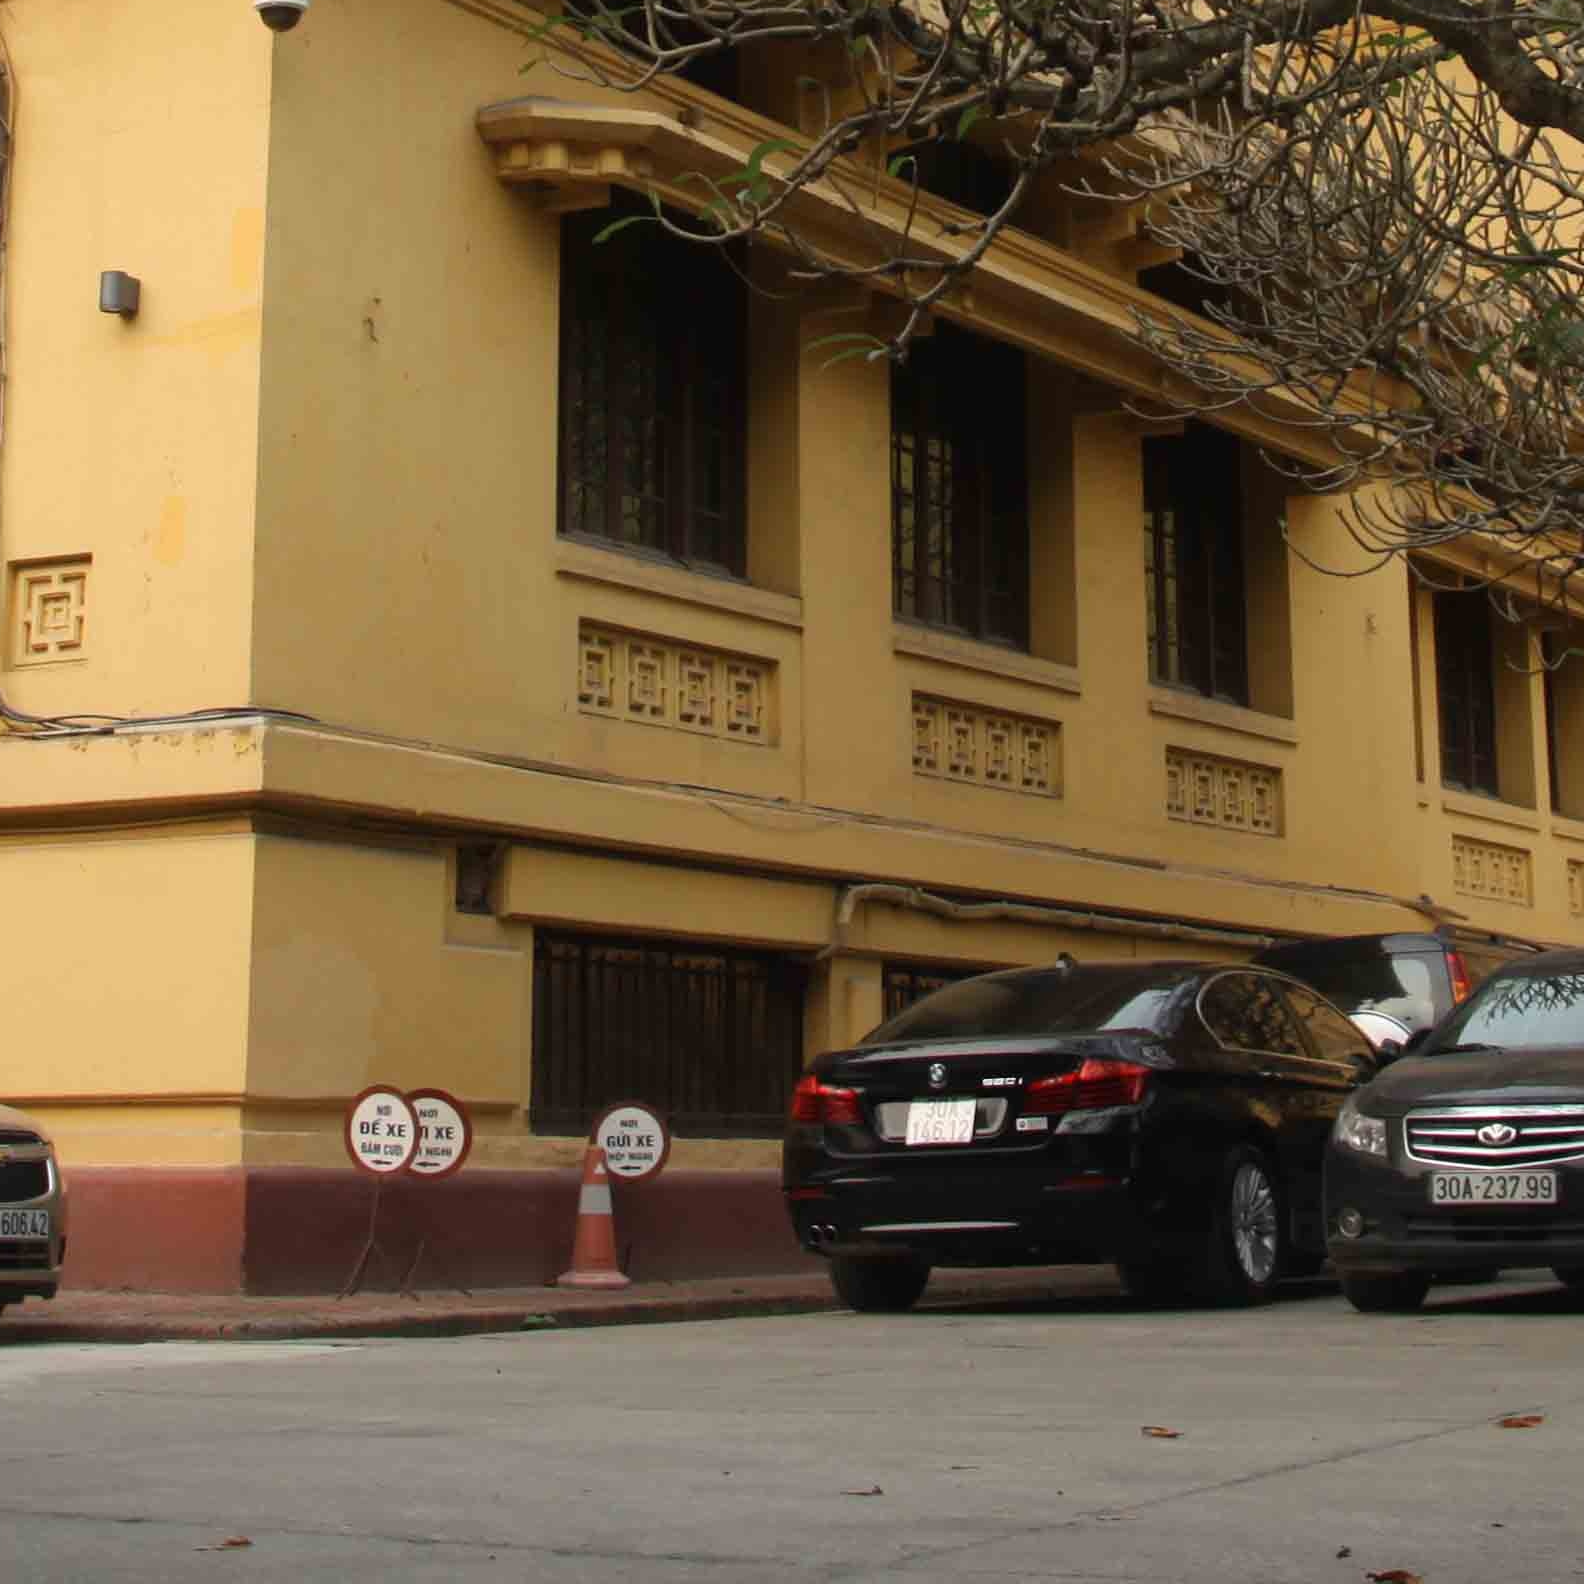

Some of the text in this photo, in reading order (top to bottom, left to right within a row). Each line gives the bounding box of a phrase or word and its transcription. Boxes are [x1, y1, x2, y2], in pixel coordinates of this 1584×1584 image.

[386, 1123, 407, 1137] XE
[434, 1126, 456, 1140] XE
[636, 1135, 656, 1147] XE
[1435, 1175, 1553, 1200] 30A-237.99
